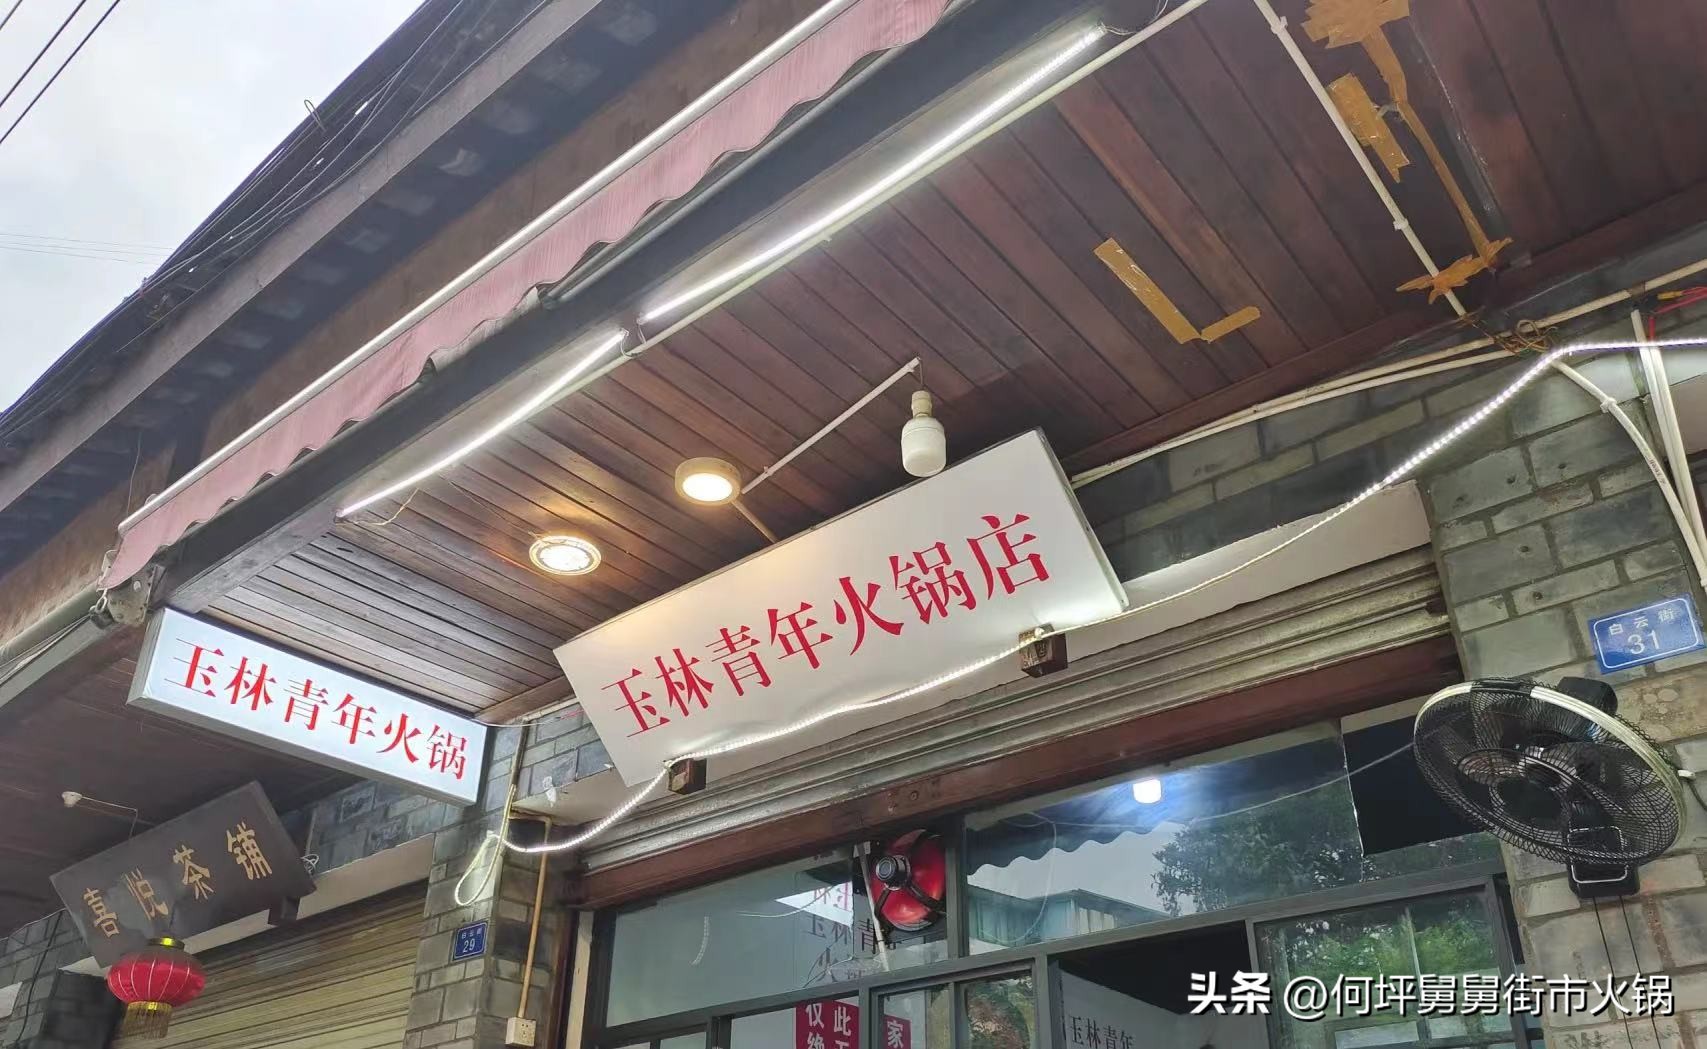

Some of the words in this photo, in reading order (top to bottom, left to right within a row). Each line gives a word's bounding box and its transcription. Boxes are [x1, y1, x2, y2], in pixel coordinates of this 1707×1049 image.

[601, 513, 1050, 738] 玉林青年火锅店
[1608, 607, 1675, 636] 白云街
[1627, 629, 1661, 655] 31
[164, 638, 467, 780] 玉林青年火锅
[462, 938, 476, 953] 29
